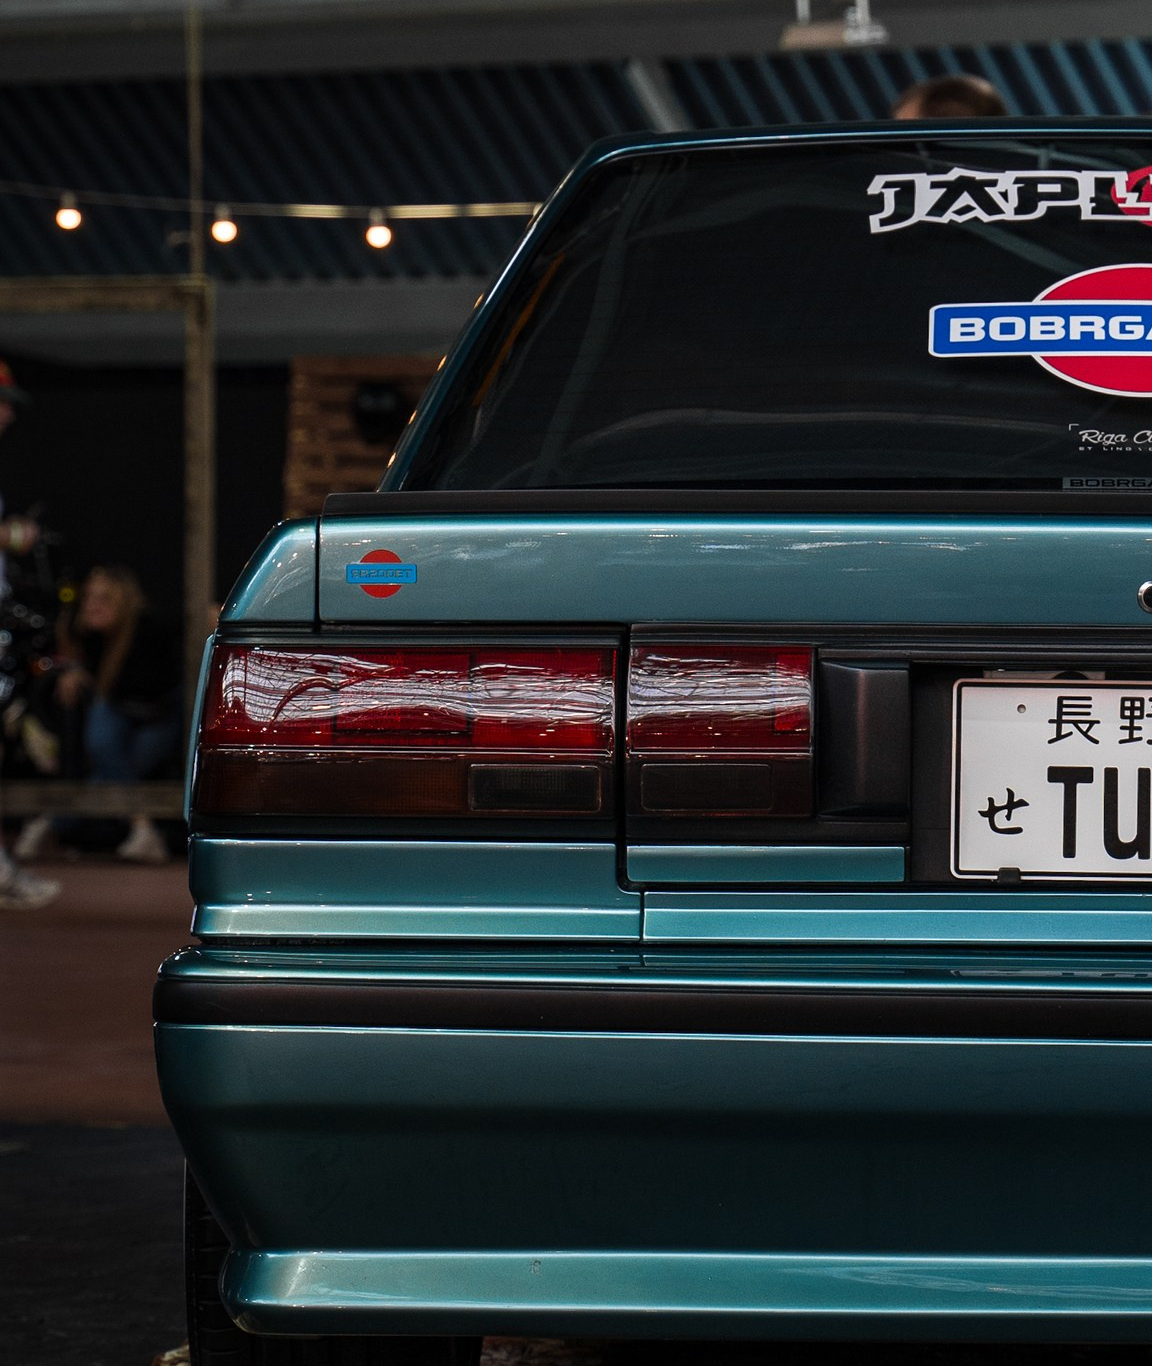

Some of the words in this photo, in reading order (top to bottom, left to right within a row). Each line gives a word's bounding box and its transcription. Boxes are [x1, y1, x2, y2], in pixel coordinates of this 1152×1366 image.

[1079, 430, 1128, 445] Riga
[350, 569, 412, 578] SR20DET
[978, 787, 1030, 835] せ
